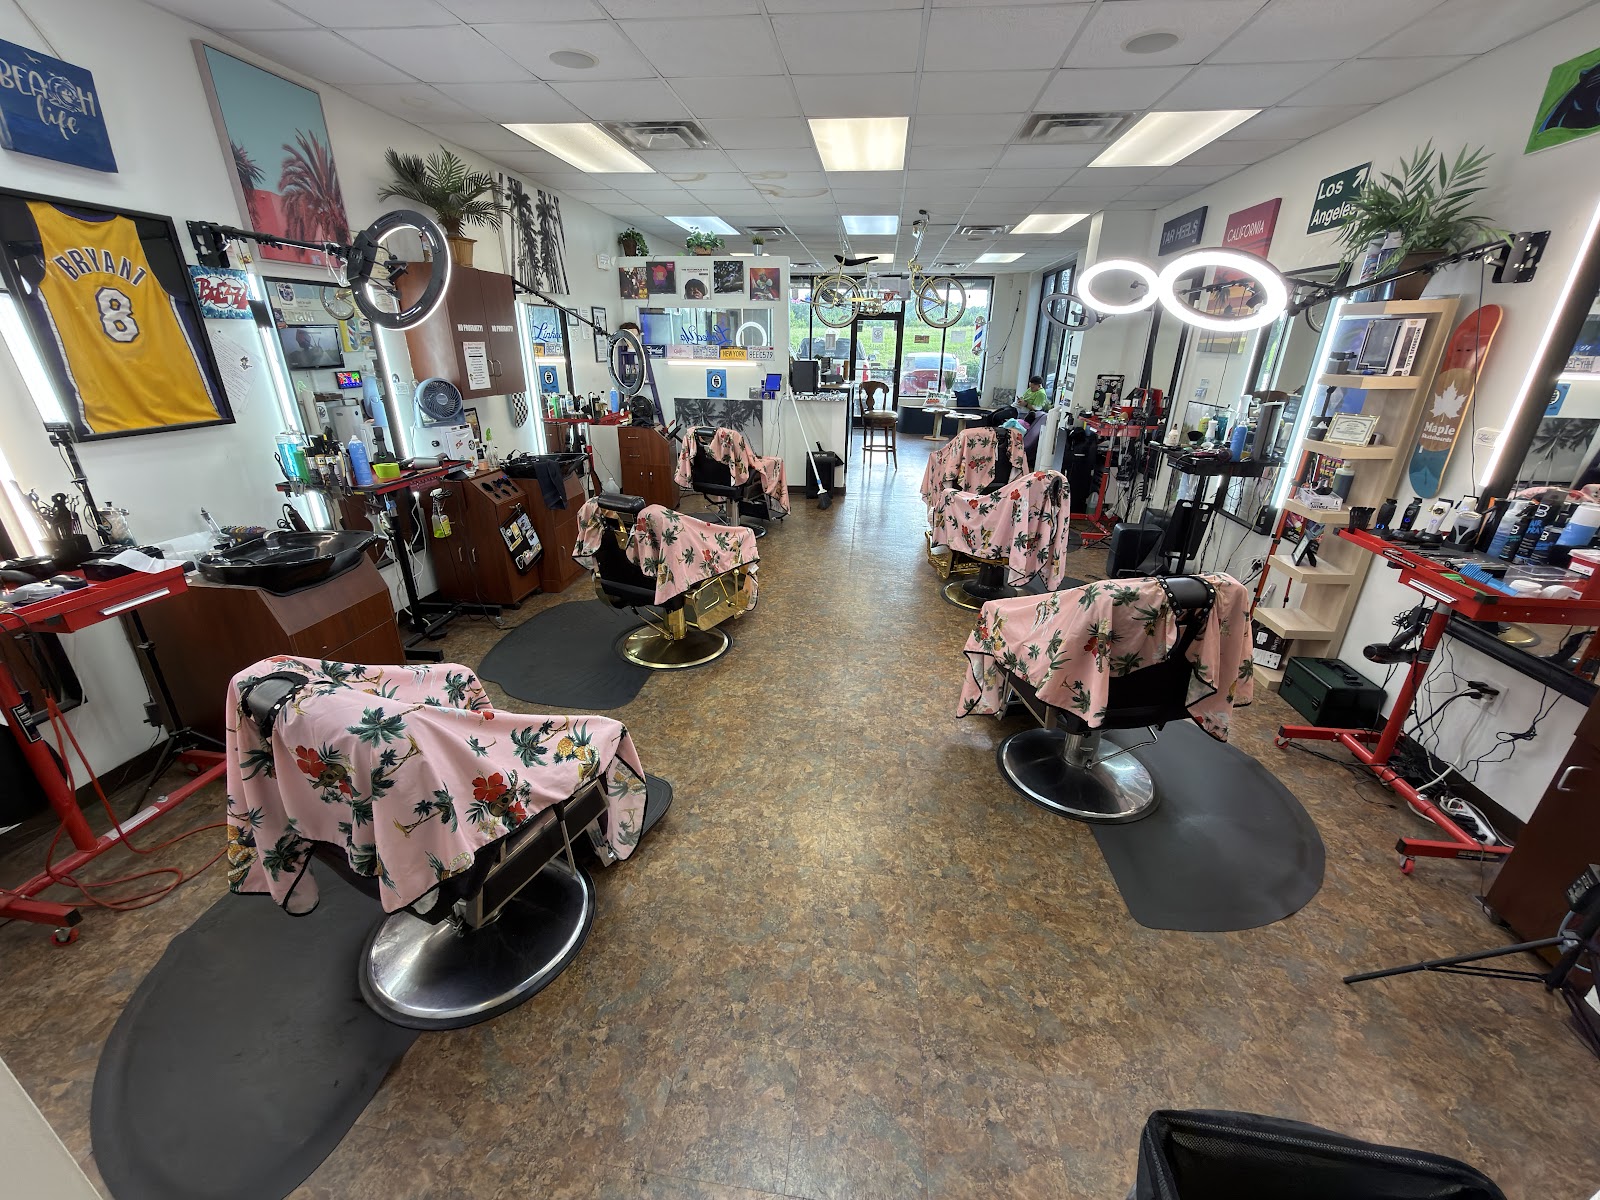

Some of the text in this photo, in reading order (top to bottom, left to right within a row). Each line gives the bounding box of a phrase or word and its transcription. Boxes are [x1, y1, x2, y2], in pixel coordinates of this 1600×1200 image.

[37, 97, 80, 141] life
[1317, 180, 1344, 200] Los
[1162, 220, 1199, 246] TAR HEELS
[1227, 220, 1265, 242] CALIFORNIA
[53, 246, 148, 288] BRYANT
[95, 286, 140, 343] 8
[1421, 433, 1453, 443] Skateboards
[1424, 421, 1456, 436] Maple
